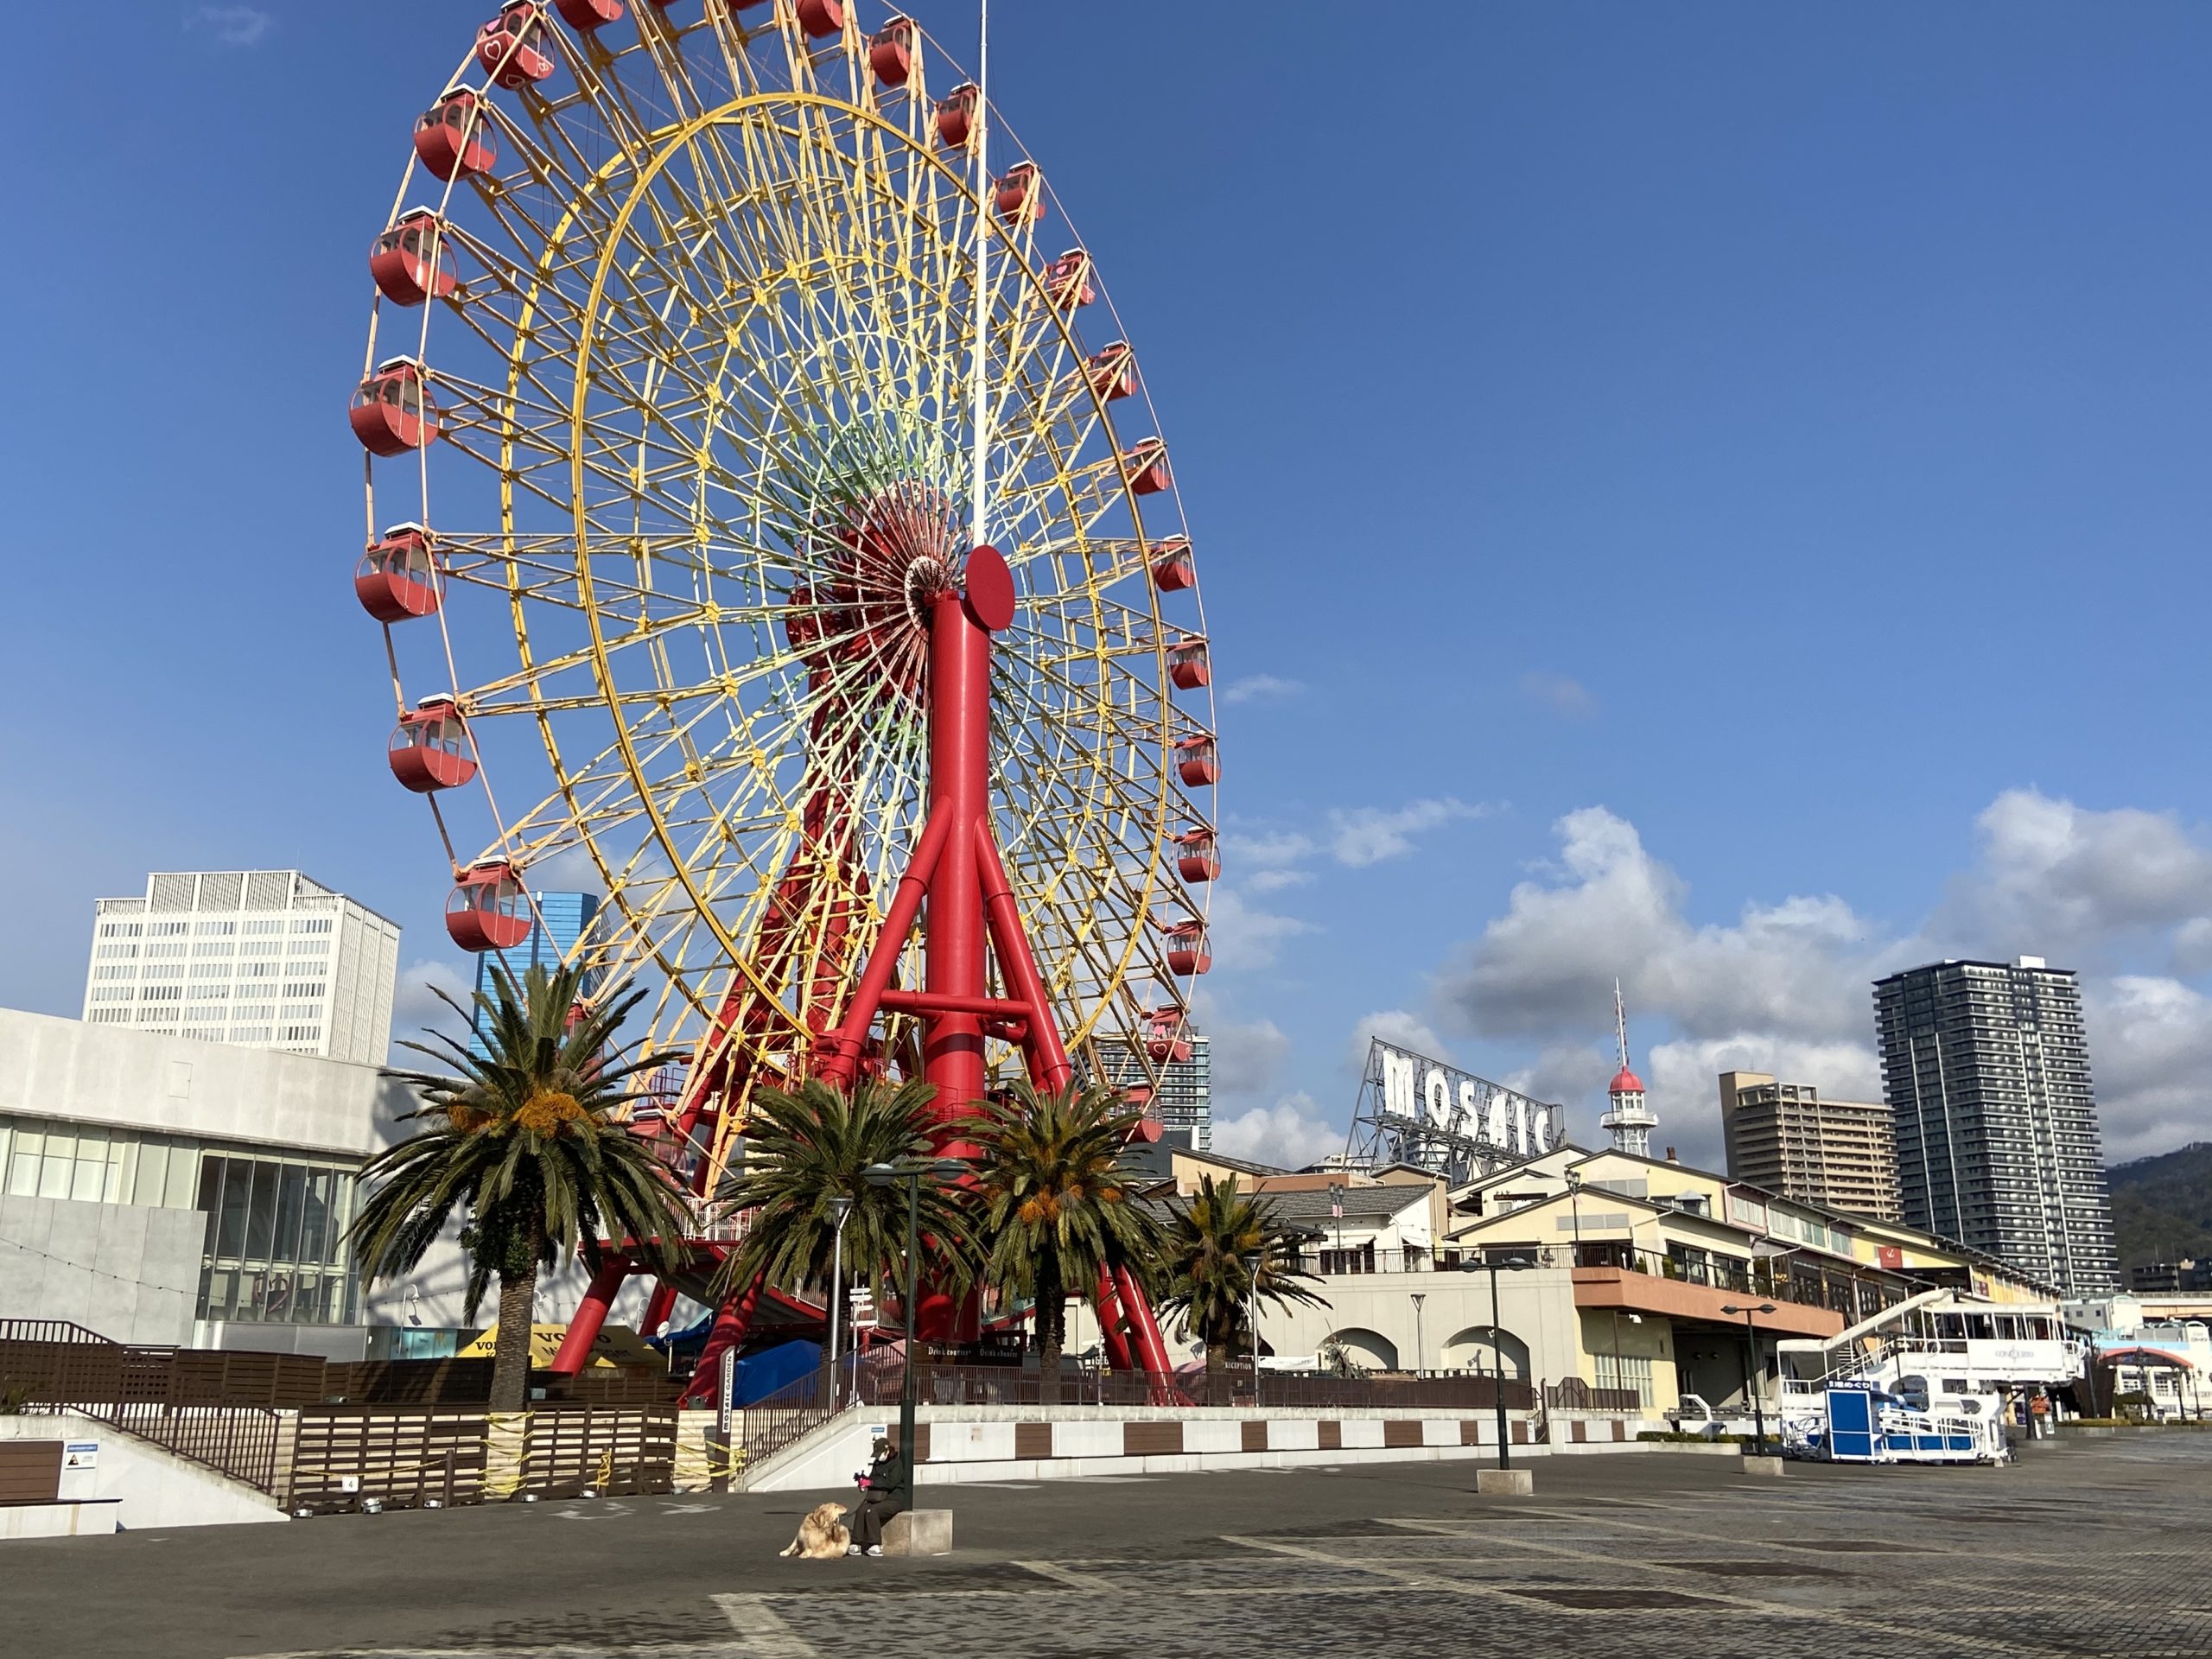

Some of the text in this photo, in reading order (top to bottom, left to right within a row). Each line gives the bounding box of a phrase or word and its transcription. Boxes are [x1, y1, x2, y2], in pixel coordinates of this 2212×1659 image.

[1383, 1050, 1549, 1156] MOSAIC
[928, 1346, 945, 1355] Drink
[1224, 1361, 1252, 1370] RECEPTION
